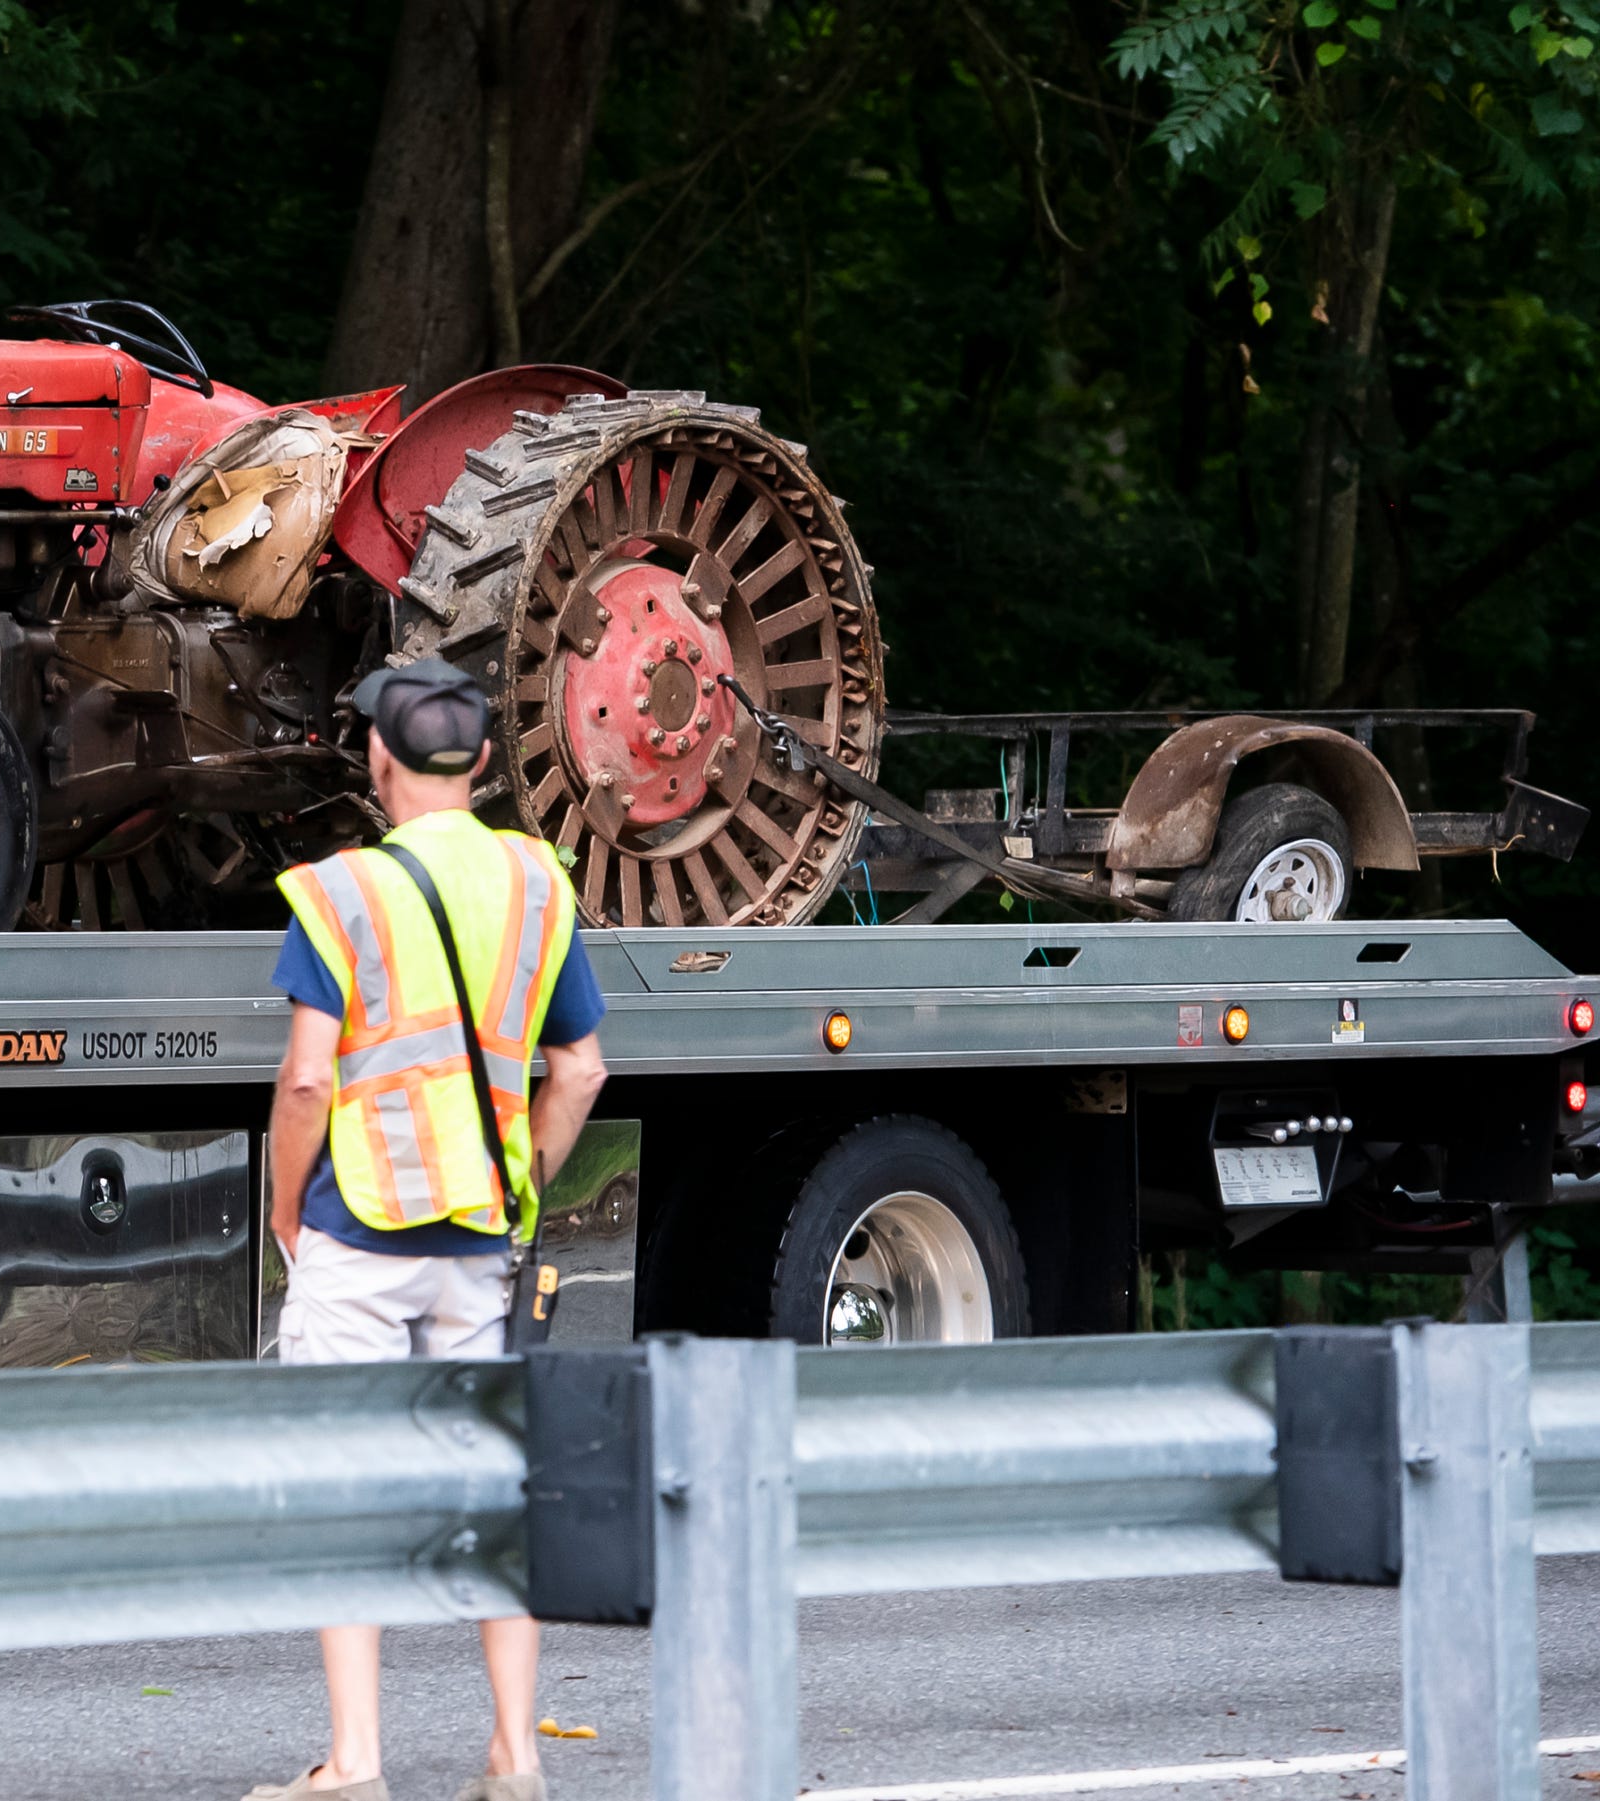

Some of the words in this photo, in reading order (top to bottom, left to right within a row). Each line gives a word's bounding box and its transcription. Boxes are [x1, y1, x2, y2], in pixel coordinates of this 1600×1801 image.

[23, 431, 47, 452] 65
[82, 1032, 147, 1059] USDOT
[154, 1031, 217, 1058] 512015
